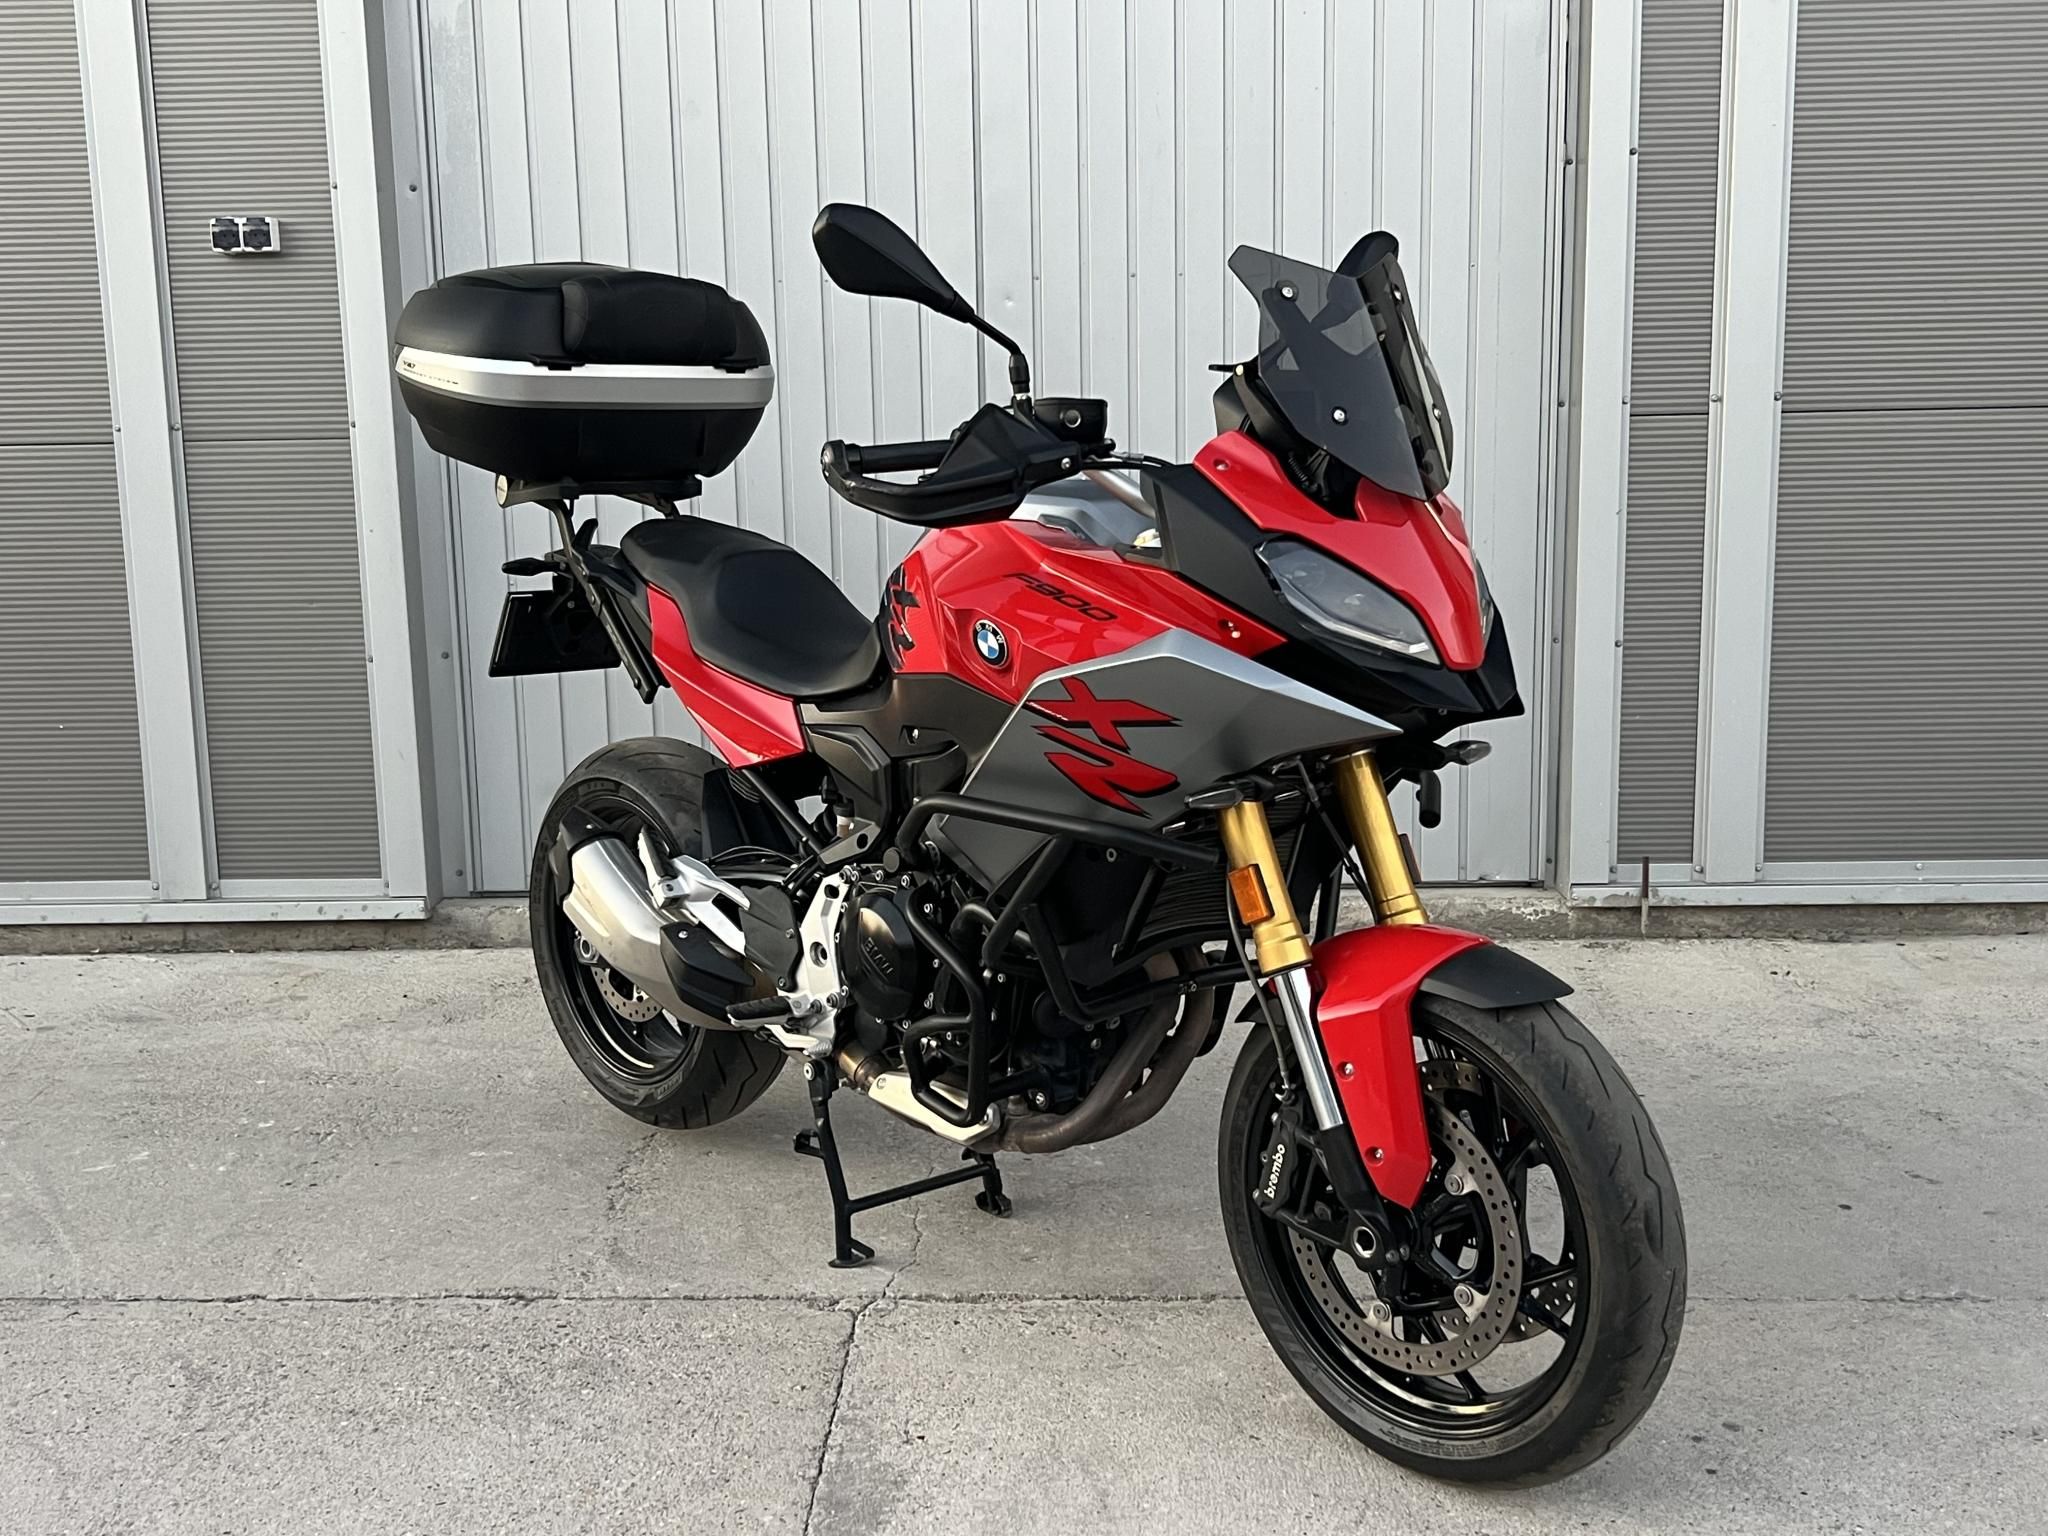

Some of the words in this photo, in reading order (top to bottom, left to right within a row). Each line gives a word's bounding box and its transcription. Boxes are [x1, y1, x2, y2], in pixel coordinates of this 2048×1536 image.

[1002, 573, 1118, 621] F900
[975, 623, 1004, 643] BMW
[1026, 676, 1183, 820] XR
[1264, 1143, 1286, 1199] brembo
